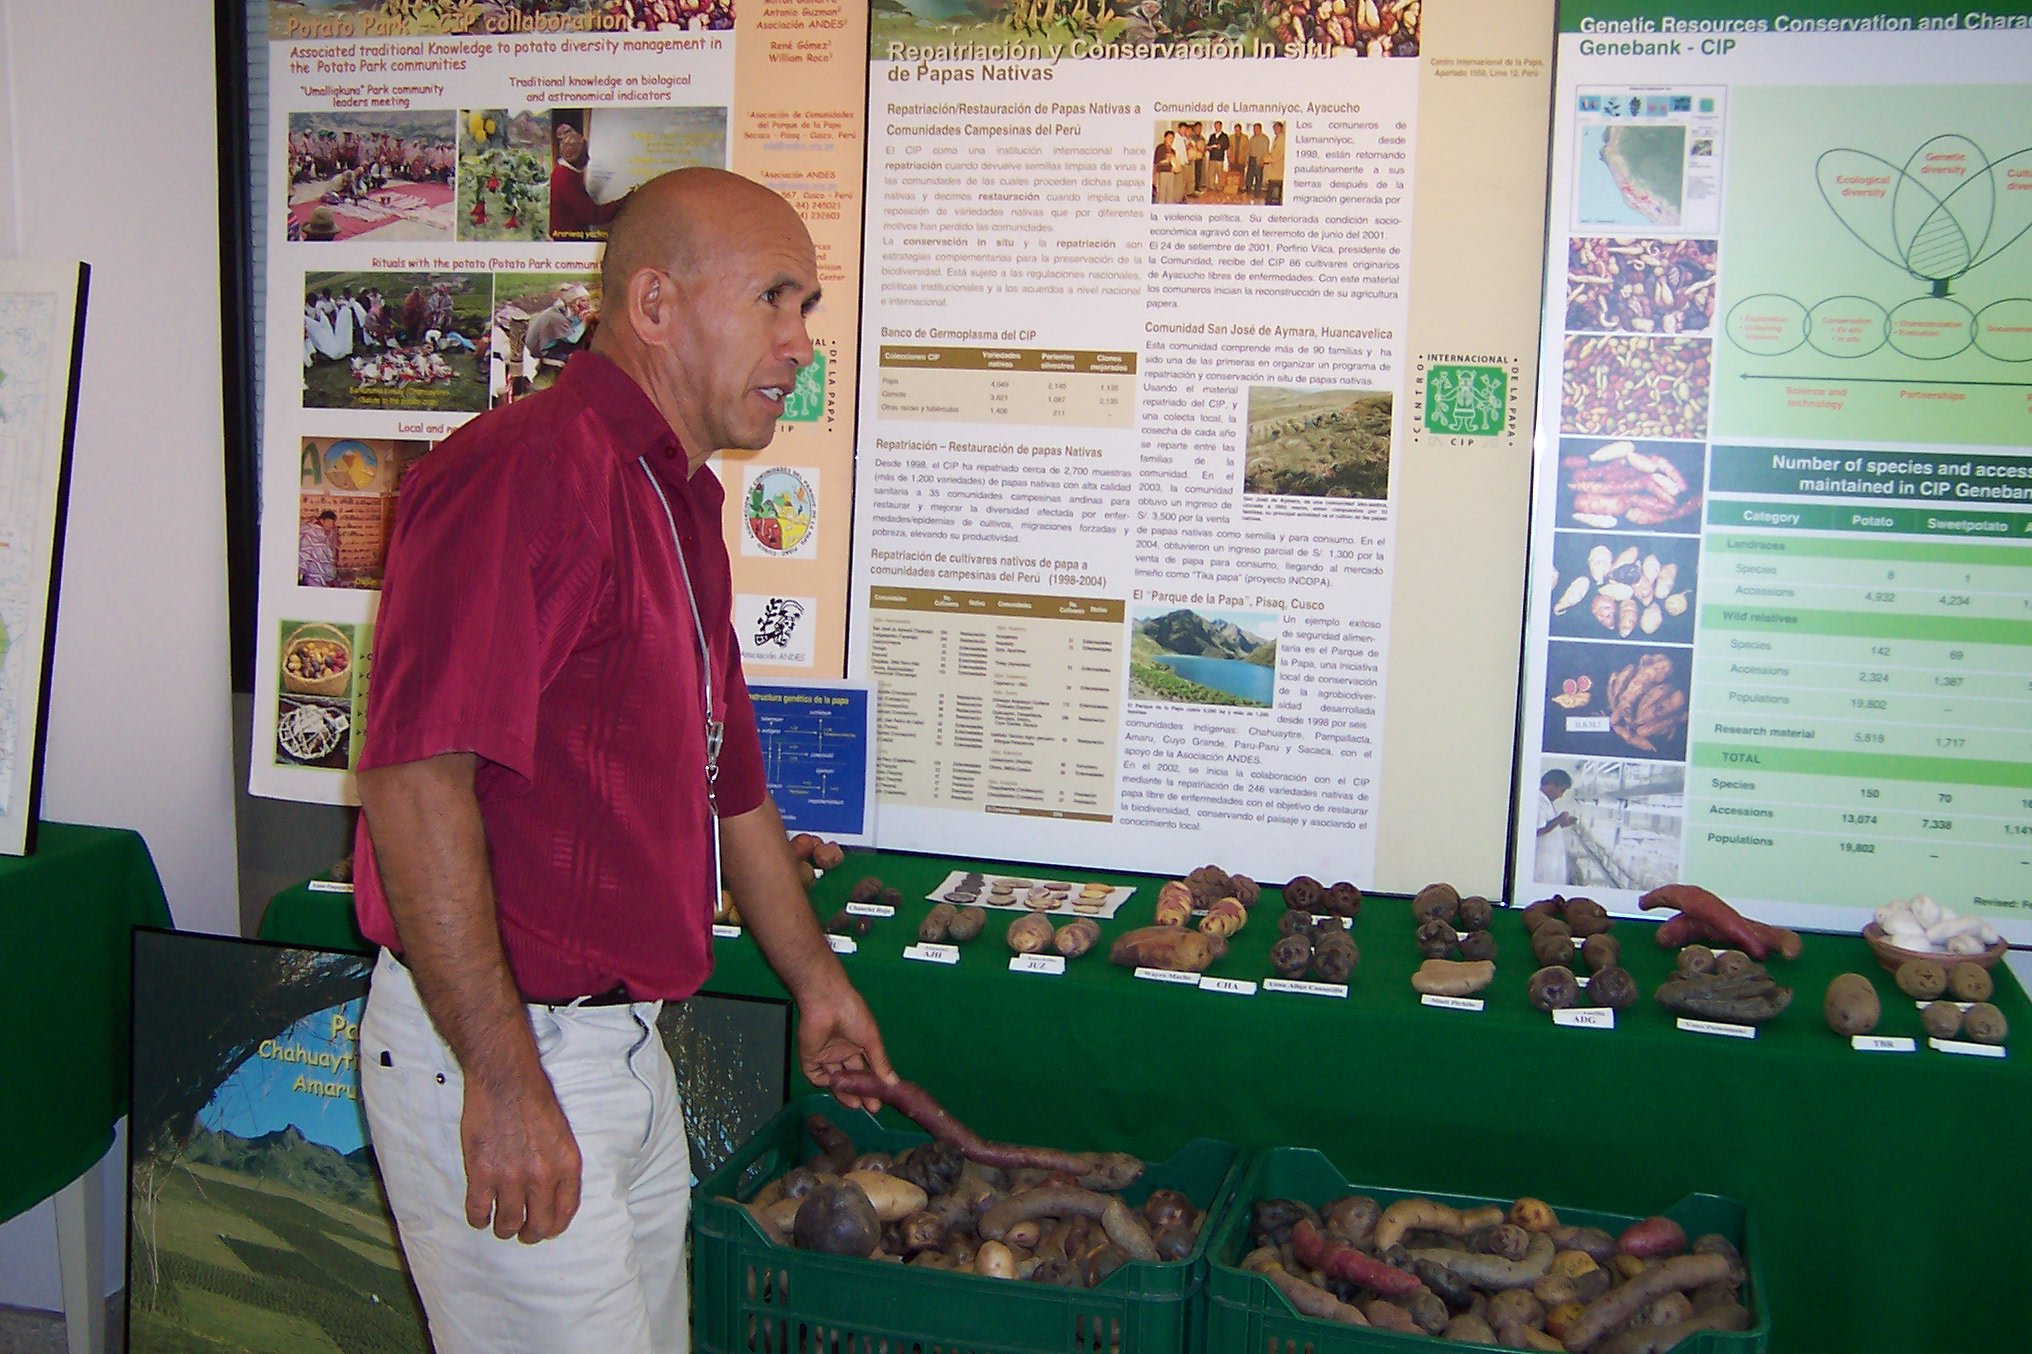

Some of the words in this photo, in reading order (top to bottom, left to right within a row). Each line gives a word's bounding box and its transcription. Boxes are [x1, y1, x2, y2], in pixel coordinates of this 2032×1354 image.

[288, 17, 354, 38] Potato
[364, 17, 410, 36] Park
[440, 15, 477, 34] CIP
[485, 9, 627, 33] collaboration
[1580, 16, 1655, 33] Genetic
[1661, 16, 1768, 33] Resources
[1774, 14, 1912, 33] Conservation
[1919, 13, 1958, 30] and
[290, 46, 355, 59] Associated
[360, 43, 423, 56] traditional
[498, 42, 510, 53] to
[514, 40, 557, 56] potato
[561, 38, 619, 55] diversity
[624, 38, 706, 54] management
[711, 37, 722, 49] in
[889, 41, 1041, 67] Repatriación
[1052, 44, 1063, 65] y
[1071, 37, 1244, 60] Conservación
[1254, 38, 1274, 59] In
[1284, 38, 1332, 60] situ
[1580, 39, 1680, 56] Genebank
[1702, 39, 1735, 55] CIP
[290, 62, 310, 74] the
[318, 62, 355, 73] Potato
[360, 61, 386, 72] Park
[391, 59, 466, 71] communities
[509, 76, 565, 87] Traditional
[569, 76, 622, 88] knowledge
[641, 75, 691, 88] biological
[888, 66, 909, 81] de
[917, 65, 974, 84] Papas
[982, 65, 1053, 81] Nativas
[368, 85, 389, 95] Park
[392, 84, 444, 96] community
[527, 91, 545, 102] and
[548, 91, 614, 101] astronomical
[618, 90, 671, 101] indicators
[333, 97, 368, 108] leaders
[372, 96, 410, 109] meeting
[1154, 102, 1213, 113] Comunidad
[1217, 102, 1229, 112] de
[1307, 102, 1360, 114] Ayacucho
[888, 103, 1031, 117] Repatriación/Restauración
[1035, 103, 1048, 114] de
[1052, 104, 1085, 117] Papas
[1089, 103, 1130, 114] Nativas
[1135, 105, 1140, 114] a
[887, 124, 960, 135] Comunidades
[964, 124, 1031, 138] Campesinas
[1036, 124, 1051, 135] del
[1056, 124, 1081, 135] Perú
[372, 258, 405, 269] Rituals
[409, 258, 429, 268] with
[433, 257, 450, 268] the
[453, 259, 485, 271] potato
[489, 258, 525, 270] (Potato
[529, 258, 551, 269] Park
[881, 327, 912, 338] Banco
[916, 329, 927, 338] de
[930, 329, 998, 343] Germoplasma
[1002, 330, 1016, 340] del
[1019, 331, 1036, 340] CIP
[1145, 322, 1204, 334] Comunidad
[1208, 323, 1227, 334] San
[1230, 324, 1255, 335] José
[1259, 325, 1271, 335] de
[1275, 325, 1318, 339] Aymara,
[1322, 327, 1393, 340] Huancavelica
[1427, 354, 1508, 364] INTERNACIONAL
[1511, 367, 1519, 381] DE
[1413, 364, 1424, 433] CENTRO
[1510, 388, 1518, 401] LA
[1828, 388, 1847, 397] and
[399, 422, 423, 432] Local
[1507, 408, 1517, 437] PAPA
[877, 439, 937, 455] Repatriación
[949, 442, 1014, 454] Restauración
[1017, 445, 1029, 455] de
[1033, 447, 1061, 458] papas
[1065, 446, 1102, 458] Nativas
[1772, 455, 1840, 471] Number
[1845, 458, 1862, 472] of
[1867, 460, 1932, 476] species
[1938, 462, 1971, 477] and
[1799, 478, 1894, 495] maintained
[1899, 481, 1914, 495] in
[1920, 482, 1950, 496] CIP
[1744, 510, 1800, 525] Category
[1852, 514, 1894, 527] Potato
[1928, 518, 2008, 532] Sweetpotato
[1727, 540, 1785, 551] Landraces
[871, 549, 932, 564] Repatriación
[935, 552, 947, 562] de
[949, 553, 998, 565] cultivares
[1001, 556, 1036, 568] nativos
[1039, 558, 1051, 569] de
[1054, 560, 1078, 571] papa
[1082, 562, 1087, 570] a
[871, 565, 935, 578] comunidades
[939, 569, 996, 583] campesinas
[1000, 571, 1014, 582] del
[1018, 572, 1040, 583] Perú
[1133, 589, 1143, 599] El
[1191, 592, 1204, 603] de
[1207, 593, 1215, 603] la
[1291, 598, 1325, 610] Cusco
[1714, 724, 1766, 736] Research
[1770, 727, 1815, 739] material
[1177, 750, 1223, 762] Asociación
[1722, 752, 1760, 764] TOTAL
[1712, 778, 1756, 790] Species
[1710, 805, 1773, 818] Accessions
[1708, 833, 1773, 847] Populations
